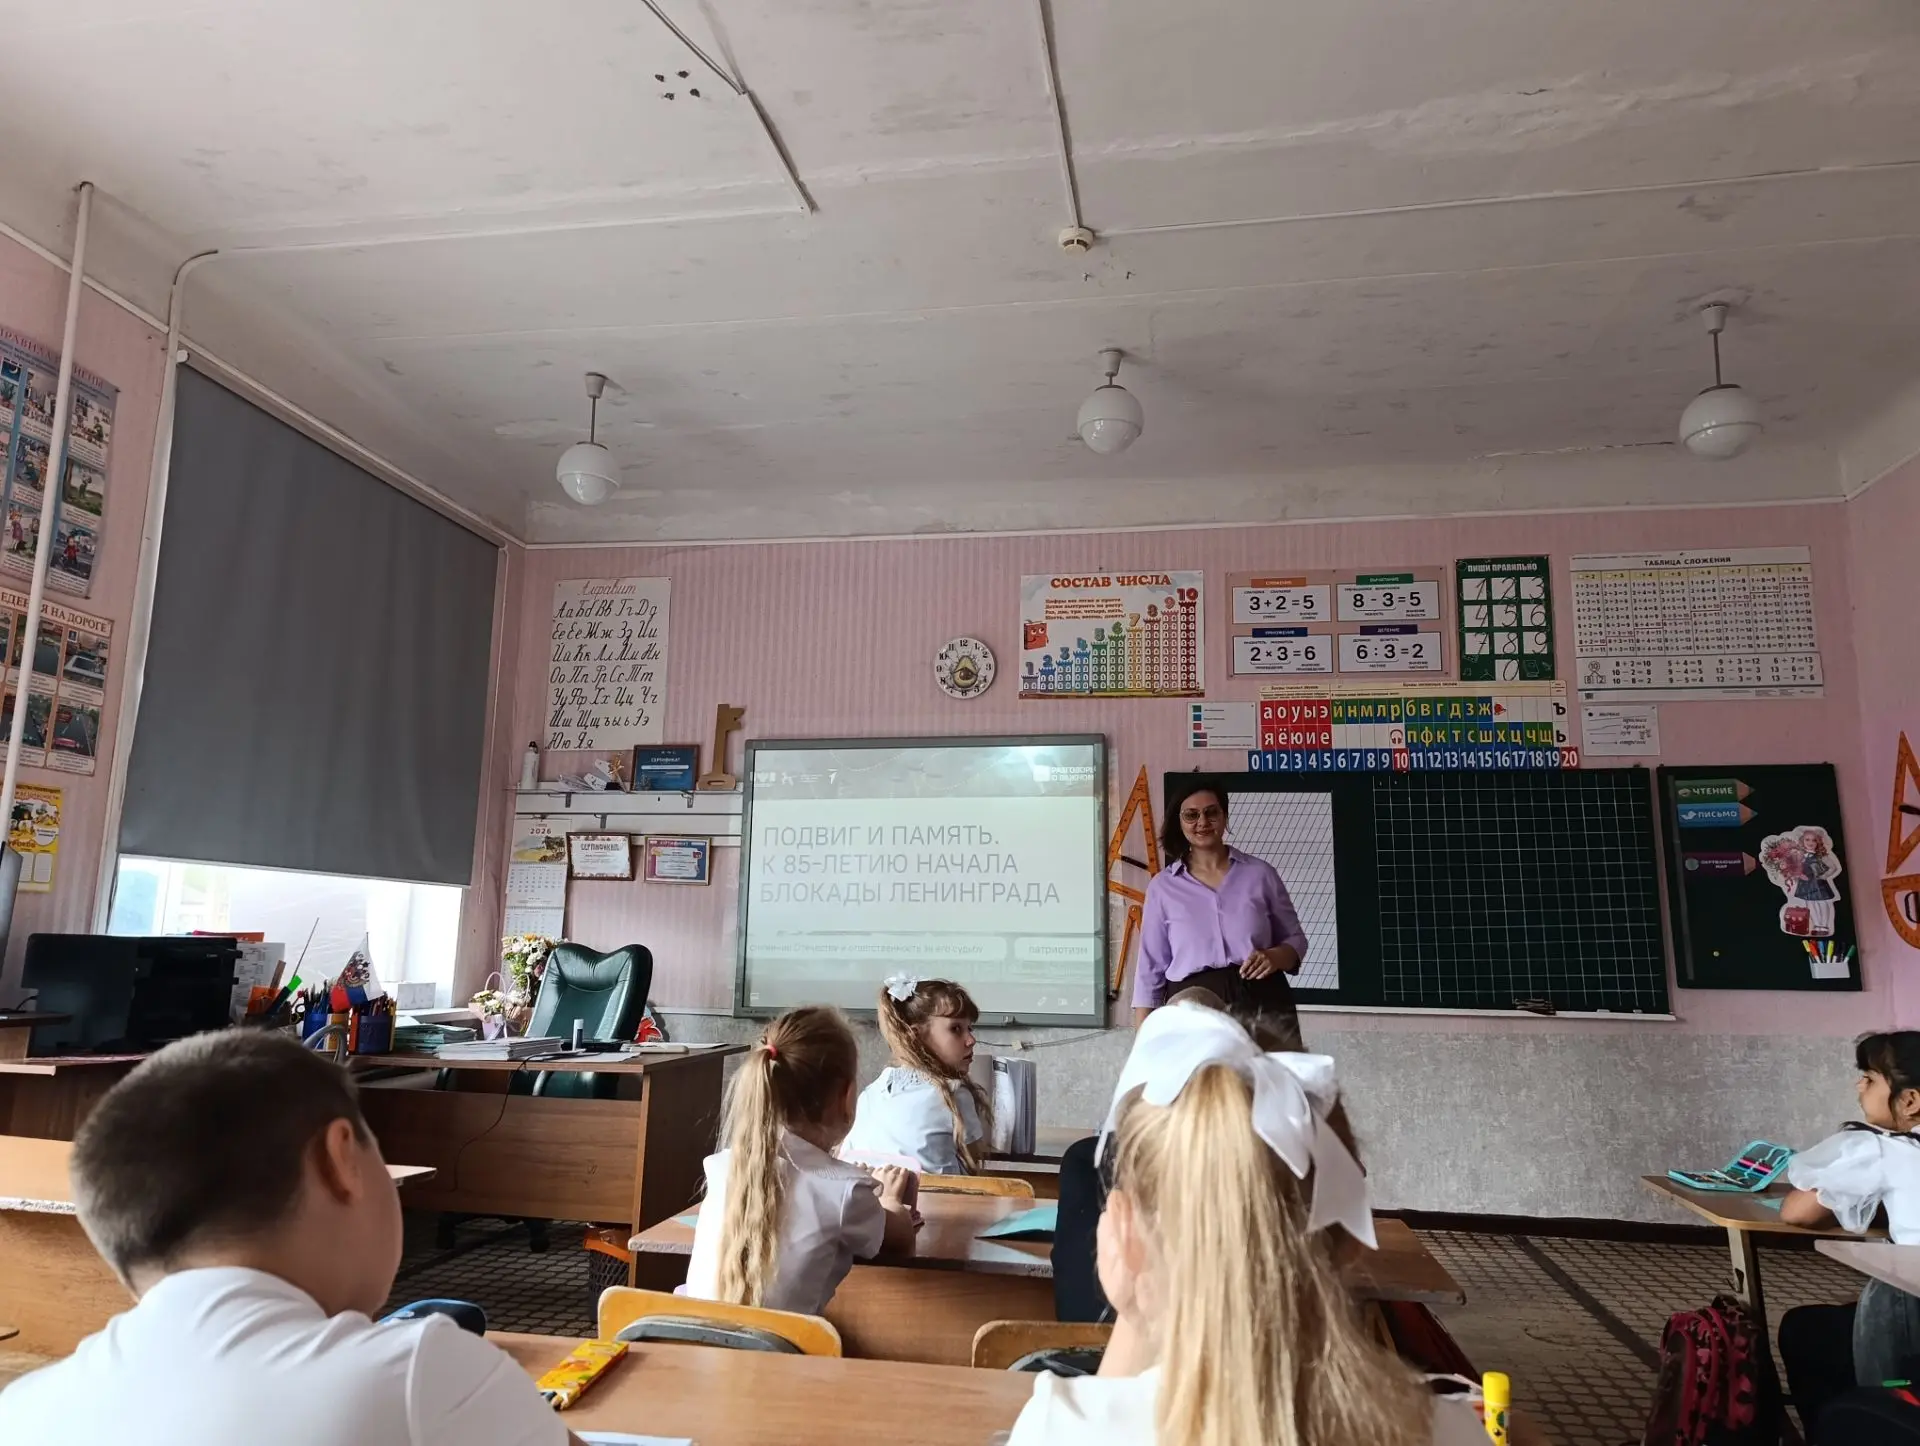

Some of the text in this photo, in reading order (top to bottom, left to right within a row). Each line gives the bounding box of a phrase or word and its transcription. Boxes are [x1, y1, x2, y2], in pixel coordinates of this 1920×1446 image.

[1468, 563, 1538, 572] ПИШИ ПРАВИЛЬНО
[1684, 557, 1732, 565] СЛОЖЕНИЯ
[1050, 574, 1172, 588] СОСТАВ ЧИСЛА
[1476, 576, 1545, 601] 1 2 3
[1176, 588, 1198, 600] 10
[1249, 596, 1260, 610] 3
[1276, 596, 1286, 610] 2
[1303, 594, 1314, 609] 5
[1353, 594, 1364, 608] 8
[1382, 592, 1394, 606] 3
[1410, 592, 1421, 606] 5
[51, 606, 107, 632] НА ДОРОГЕ
[1476, 604, 1546, 628] 4 5 6
[1356, 644, 1368, 660] 6
[1384, 644, 1396, 658] 3
[1412, 644, 1424, 658] 2
[1474, 632, 1547, 654] 7 8 9
[1250, 646, 1261, 662] 2
[1277, 646, 1288, 660] 3
[1304, 646, 1316, 660] 6
[1264, 700, 1566, 723] а о у ы э й н м л р б в г д з ж ъ
[1264, 726, 1566, 748] я ё ю и е п ф к т с ш х ц ч щ ь
[1252, 751, 1578, 770] 0 1 2 3 4 5 6 7 8 9 10 11 12 13 14 15 16 17 18 19 20
[764, 824, 1000, 849] ПОДВИГ И ПАМЯТЬ.
[762, 854, 1018, 875] К 85-ЛЕТИЮ НАЧАЛА
[760, 882, 1060, 907] БЛОКАДЫ ЛЕНИНГРАДА
[1028, 946, 1088, 956] патриотизм
